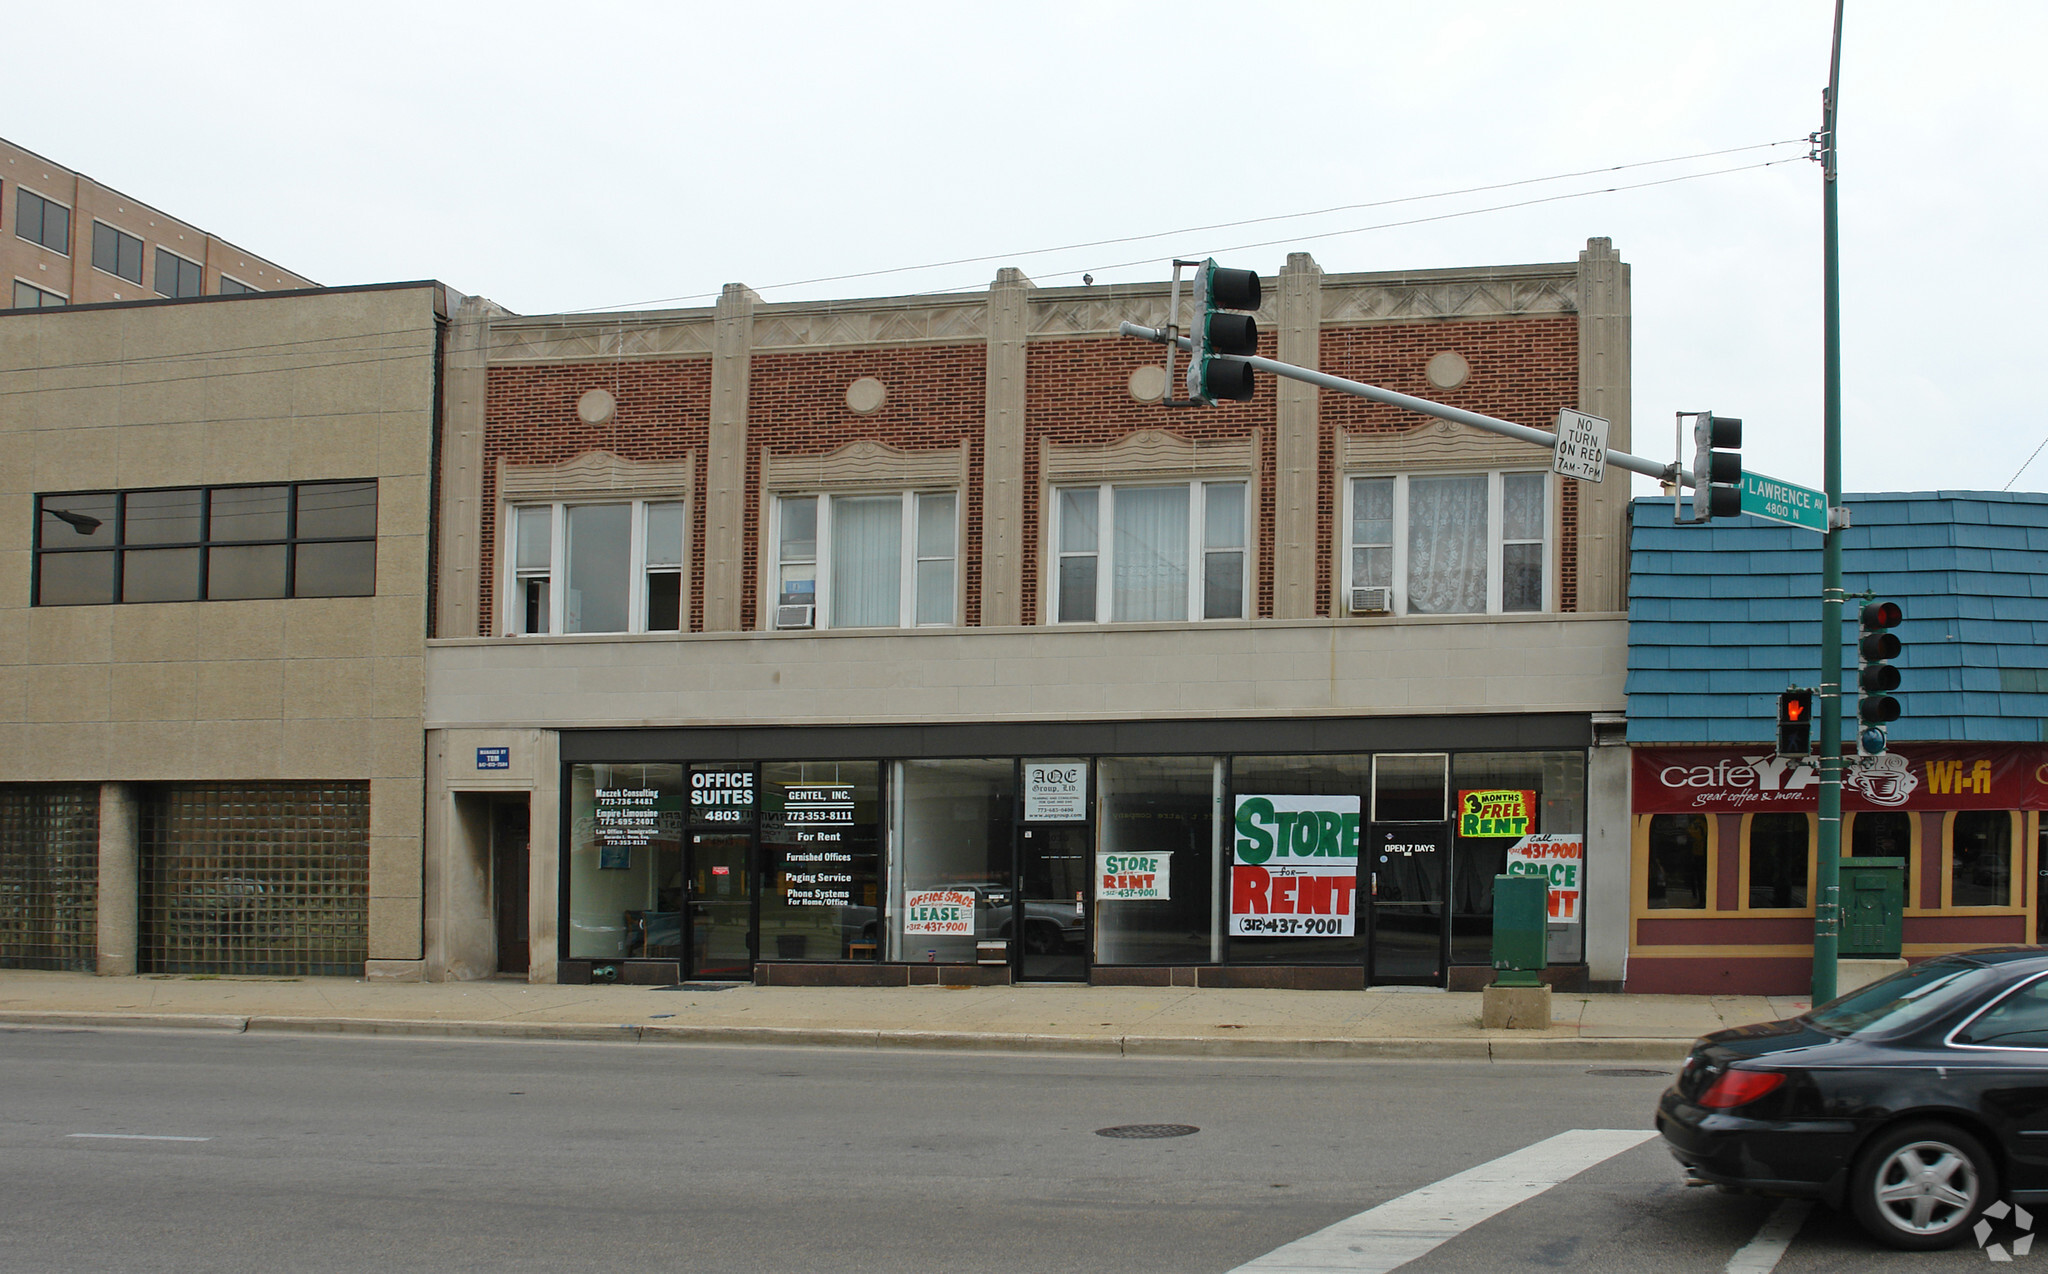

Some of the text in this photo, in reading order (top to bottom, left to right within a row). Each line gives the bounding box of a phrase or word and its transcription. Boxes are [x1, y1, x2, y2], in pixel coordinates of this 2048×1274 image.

[1577, 418, 1592, 431] NO
[1569, 429, 1598, 447] TURN
[1560, 441, 1602, 462] ON RED
[1749, 478, 1811, 509] LAWRENCE
[1814, 499, 1823, 509] AV
[1765, 502, 1799, 520] 4800 N
[691, 773, 753, 788] OFFICE
[1032, 769, 1078, 784] AQE
[1926, 760, 1992, 794] Wi-fi
[595, 789, 659, 799] Maczek Consulting
[788, 791, 851, 801] GENTEL, INC.
[1032, 784, 1079, 793] Group, Ltd.
[691, 790, 754, 805] SUITES
[1466, 794, 1520, 814] 3 MONTHS
[1692, 789, 1728, 807] great
[1727, 788, 1759, 808] coffee
[1761, 791, 1771, 800] &
[596, 809, 659, 819] Empire Limousine
[705, 811, 740, 821] 4803
[787, 812, 852, 820] 773-353-8111
[1480, 803, 1521, 819] FREE
[1235, 797, 1360, 865] STORE
[1463, 814, 1527, 835] RENT
[797, 832, 841, 841] For Rent
[1384, 844, 1435, 853] OPEN 7 DAYS
[786, 853, 851, 861] Furnished Offices
[1106, 855, 1159, 874] STORE
[785, 873, 852, 883] Paging Service
[1103, 873, 1155, 889] RENT
[787, 889, 850, 899] Phone Systems
[1232, 865, 1357, 915] RENT
[802, 898, 849, 906] Home/Office
[910, 891, 975, 908] OFFICE SPACE
[911, 907, 960, 921] LEASE
